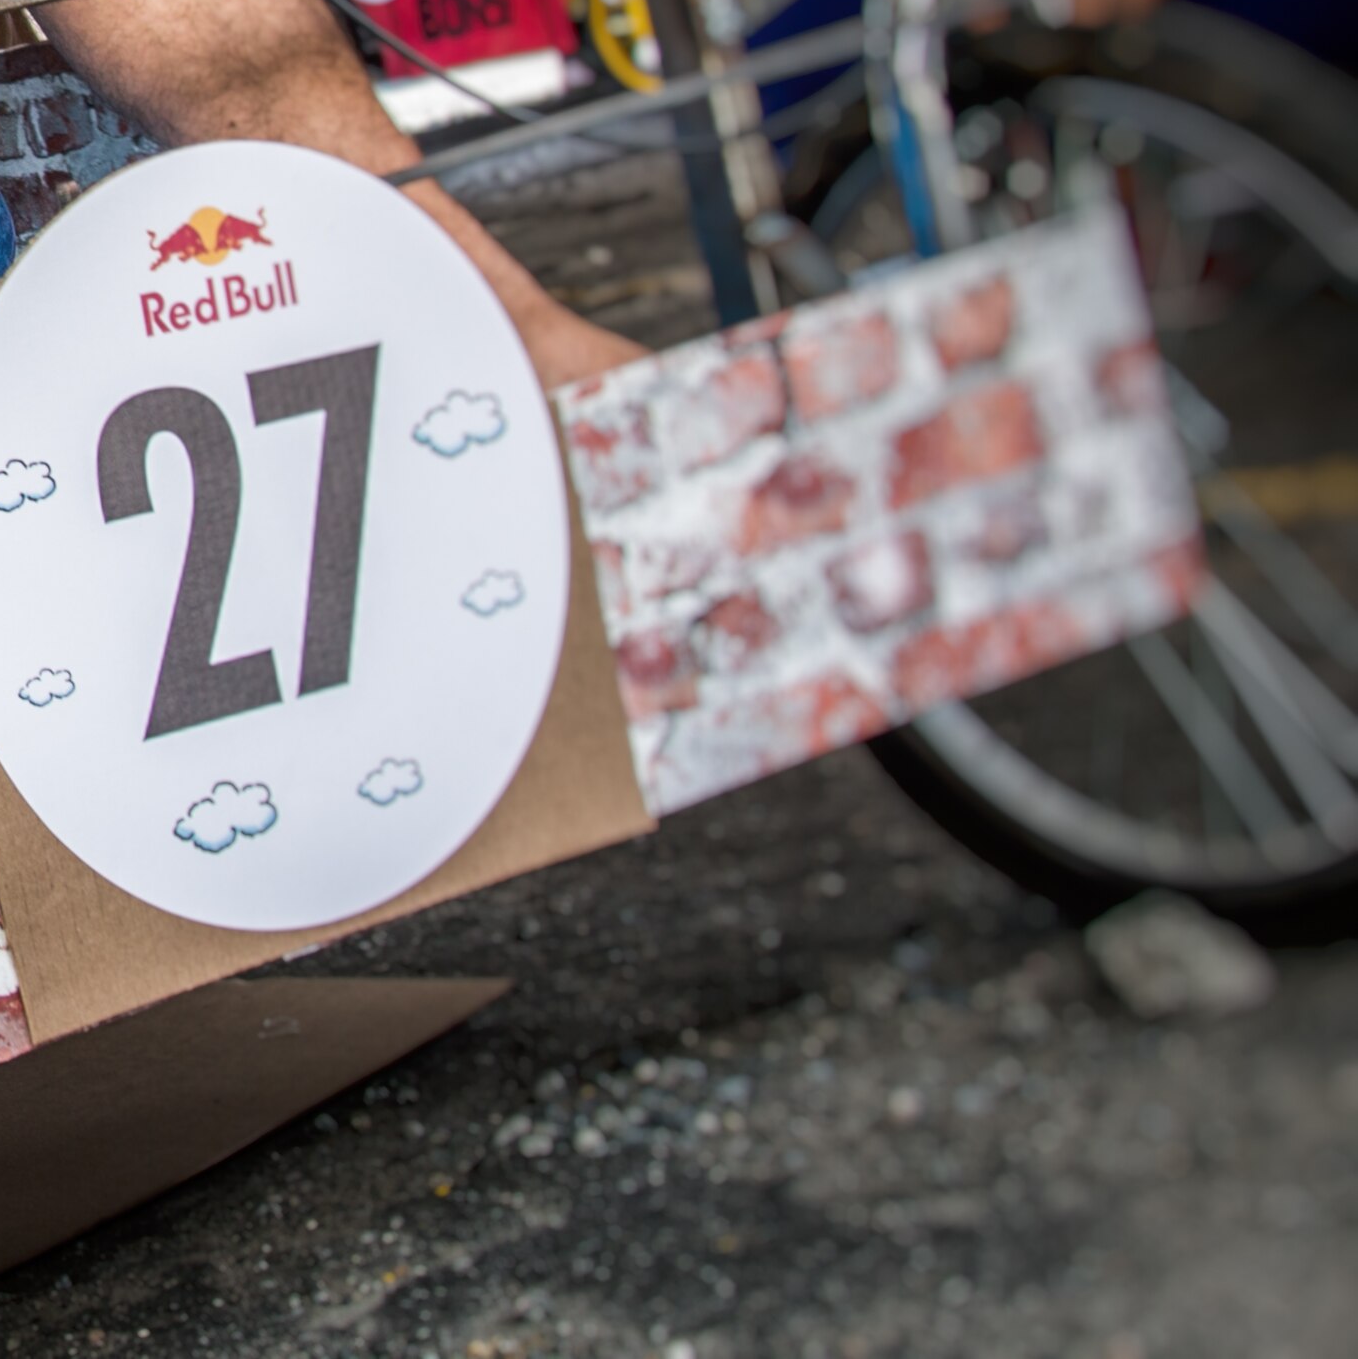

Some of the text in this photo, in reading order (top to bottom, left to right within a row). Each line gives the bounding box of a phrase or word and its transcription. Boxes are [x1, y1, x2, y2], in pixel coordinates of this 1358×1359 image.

[139, 260, 298, 337] Red Bull
[96, 341, 382, 743] 27
